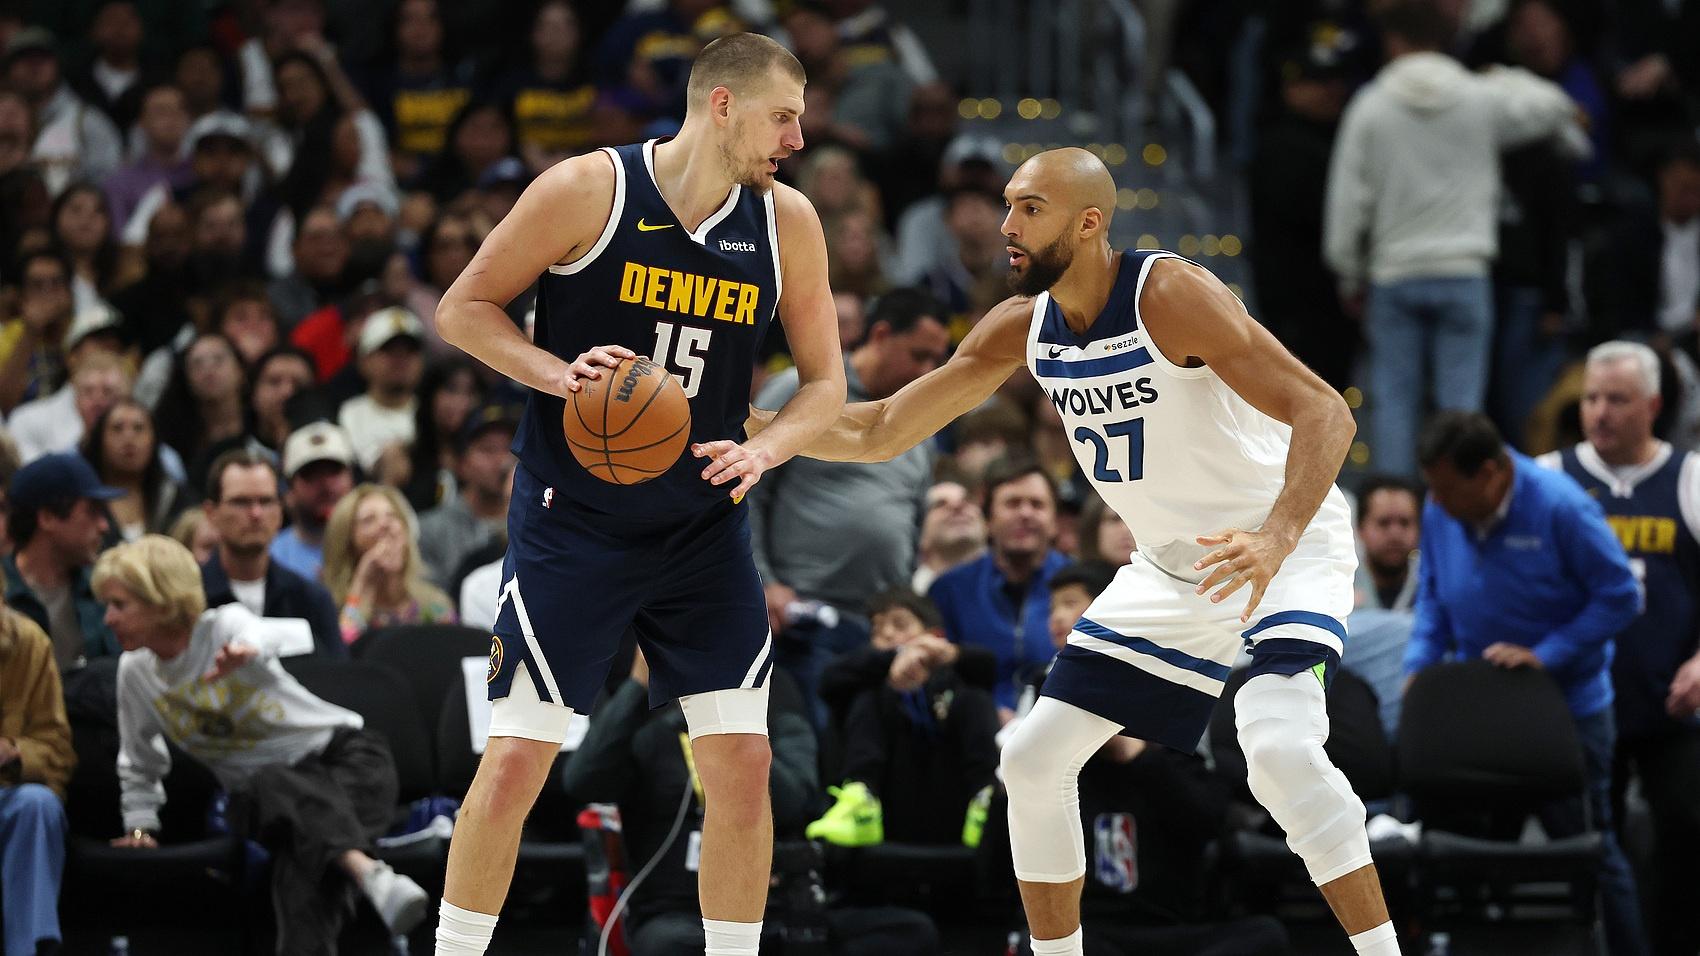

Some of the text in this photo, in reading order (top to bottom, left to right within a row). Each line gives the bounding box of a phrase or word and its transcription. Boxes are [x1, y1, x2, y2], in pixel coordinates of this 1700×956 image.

[719, 240, 756, 252] ibotta
[620, 262, 759, 325] DENVER
[653, 321, 713, 398] 15
[1111, 336, 1139, 351] sezzle
[1045, 377, 1158, 416] WOLVES
[1074, 417, 1144, 482] 27
